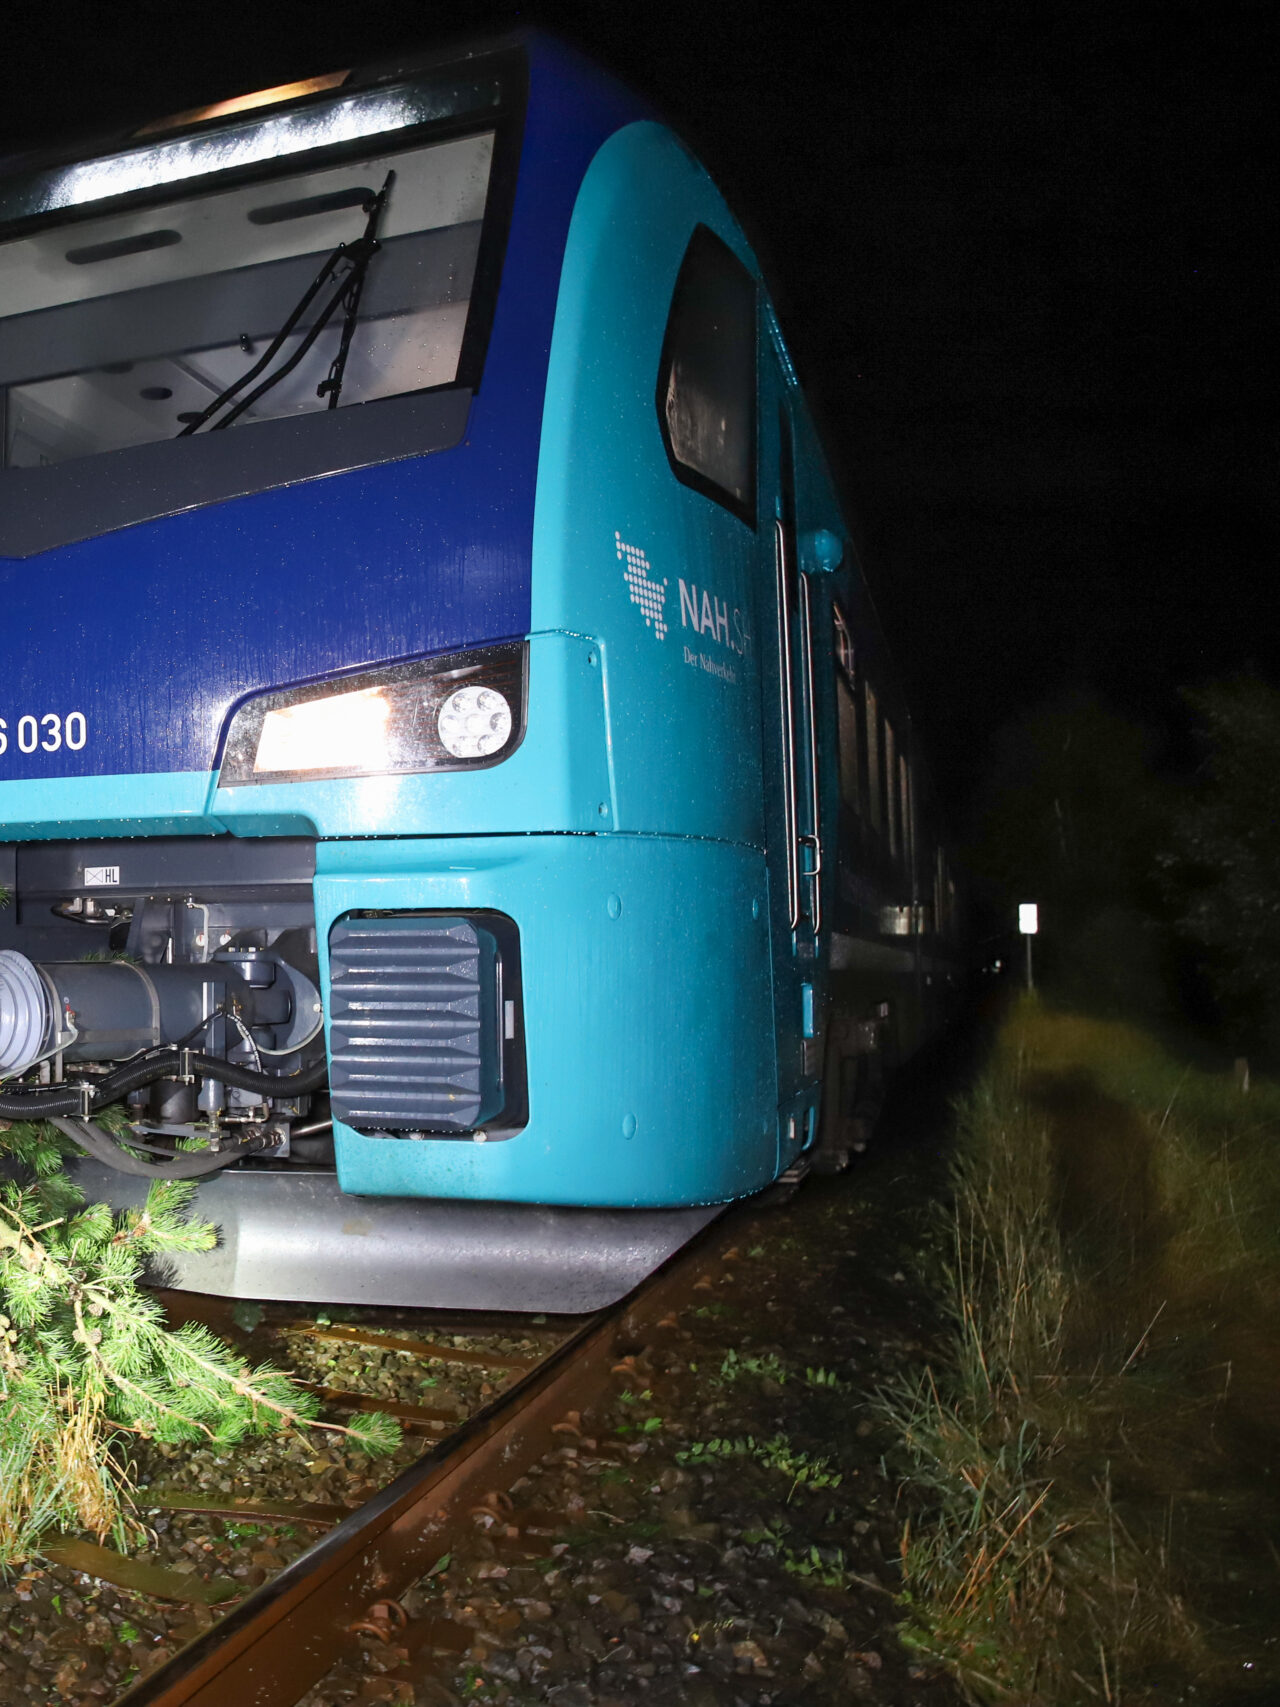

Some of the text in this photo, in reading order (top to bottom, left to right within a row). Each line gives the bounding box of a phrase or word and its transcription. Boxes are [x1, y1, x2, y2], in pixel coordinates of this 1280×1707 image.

[683, 646, 698, 667] Der
[18, 711, 87, 754] 030
[104, 868, 118, 883] HL
